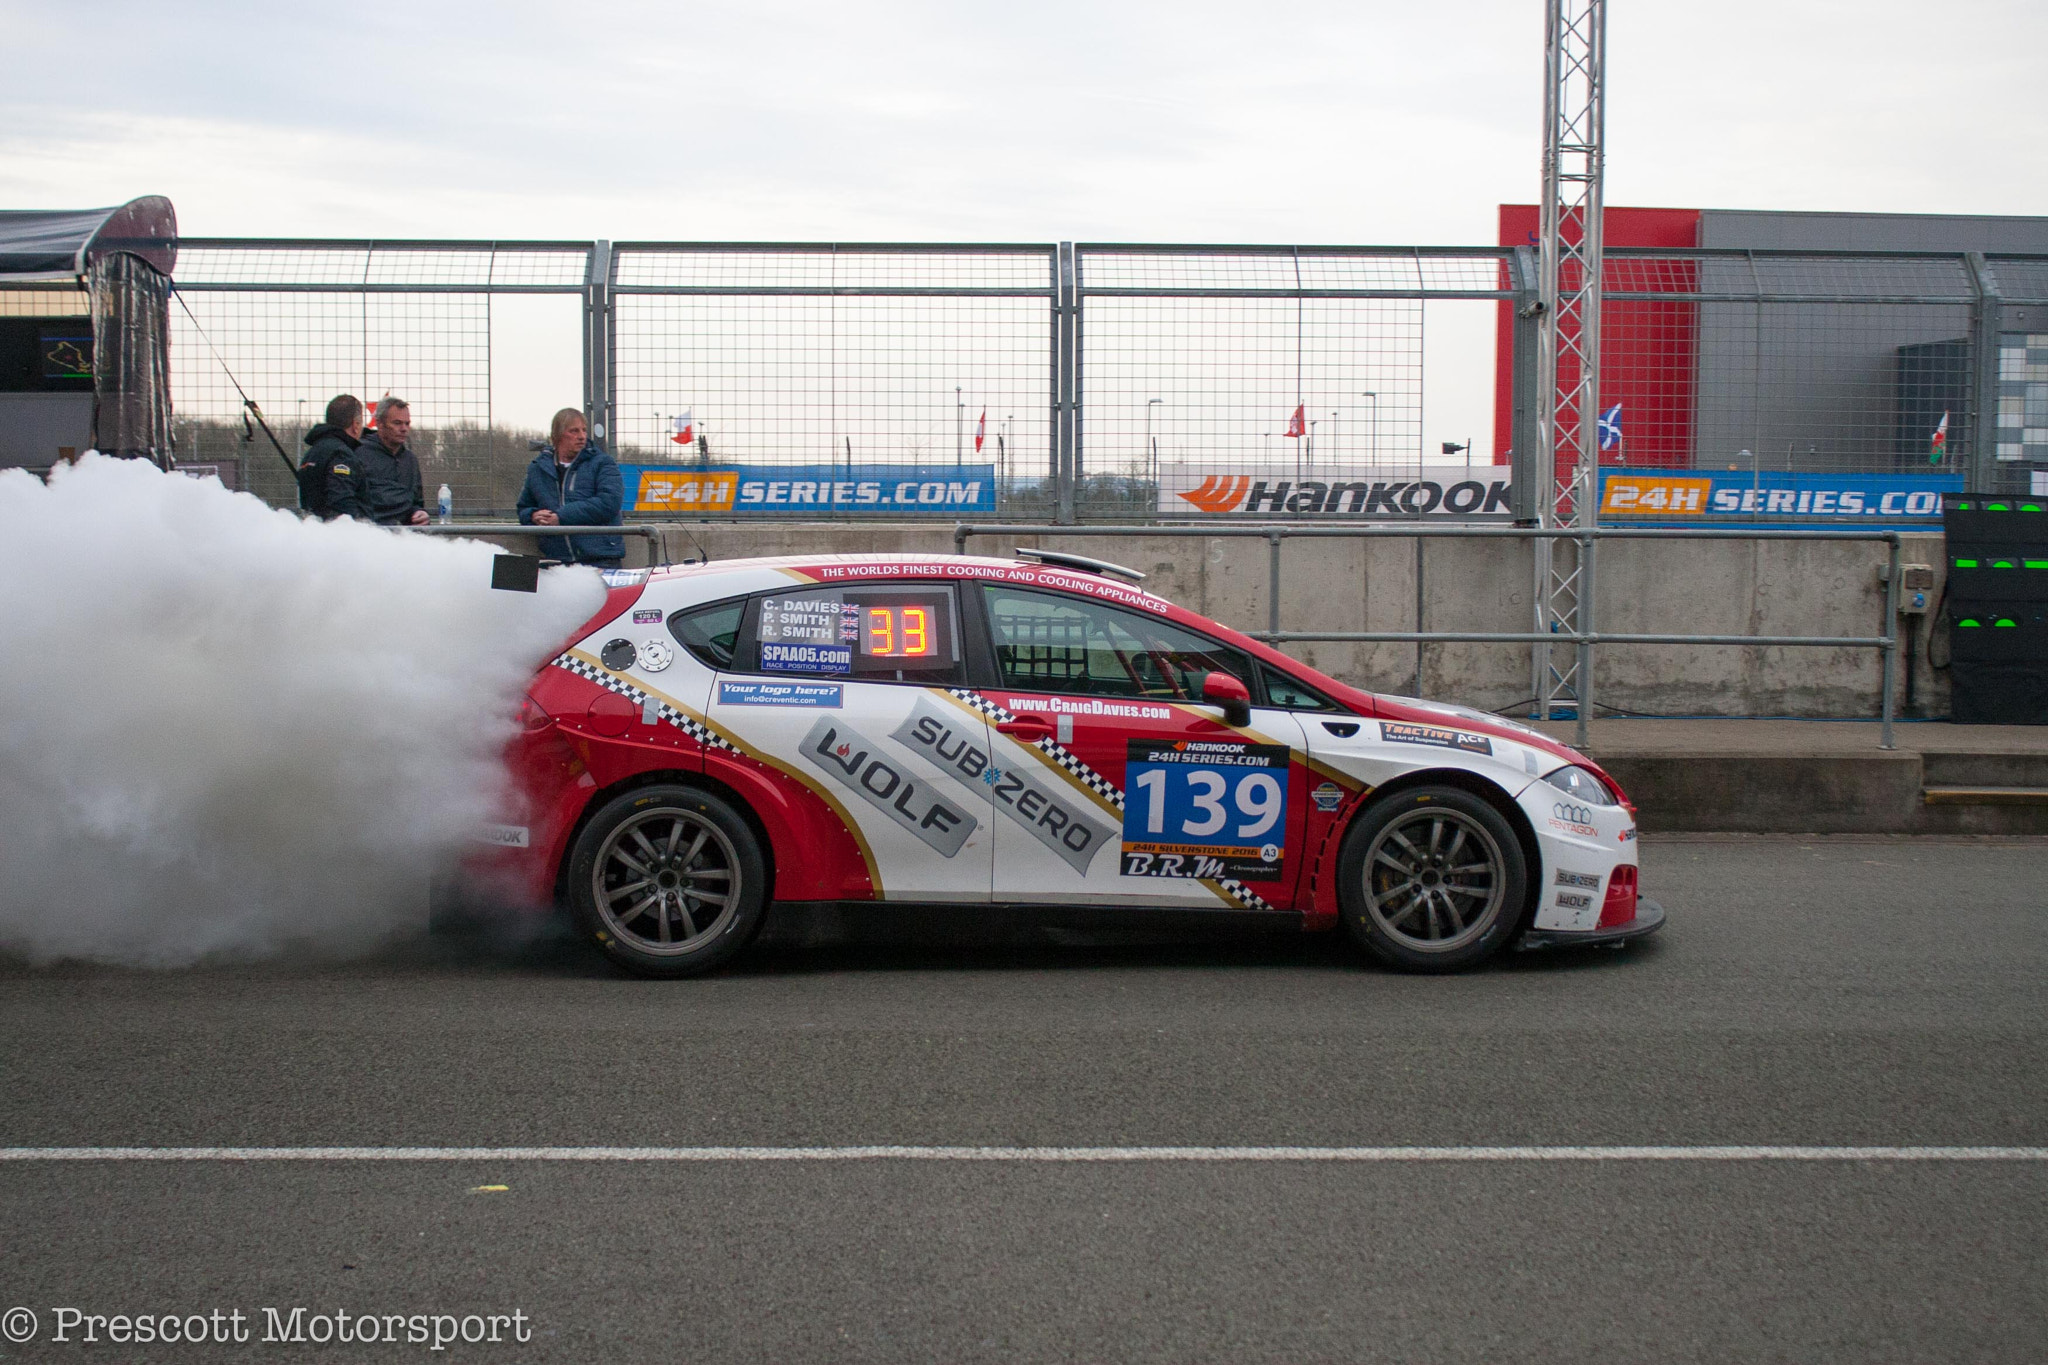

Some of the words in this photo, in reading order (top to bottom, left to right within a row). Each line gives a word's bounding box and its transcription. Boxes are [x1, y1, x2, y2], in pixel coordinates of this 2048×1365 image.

[740, 481, 982, 504] SERIES.COM
[1713, 488, 1944, 515] SERIES.CO
[822, 567, 845, 577] THE
[846, 565, 900, 576] WORLDS
[902, 565, 944, 575] FINEST
[946, 565, 1005, 578] COOKING
[1007, 570, 1035, 582] AND
[1037, 574, 1094, 593] COOLING
[1095, 586, 1168, 613] APPLIANCES
[763, 599, 779, 610] C.
[783, 600, 840, 614] DAVIES
[763, 612, 775, 623] P.
[780, 613, 830, 626] SMITH
[762, 625, 777, 636] R.
[782, 626, 832, 639] SMITH
[870, 609, 926, 655] 33
[723, 683, 757, 694] Your
[760, 684, 791, 696] logo
[795, 686, 838, 696] here?
[744, 695, 817, 705] info@creventic.com
[1457, 734, 1486, 744] ACE
[1148, 752, 1183, 762] 24H
[1182, 754, 1270, 767] SERIES.COM
[816, 727, 962, 833] WOLF
[1136, 769, 1282, 838] 139
[1548, 819, 1599, 837] PENTAGON
[1133, 843, 1155, 851] 24H
[1158, 845, 1229, 855] SILVERSTONE
[1231, 848, 1258, 856] 2016
[1262, 847, 1277, 858] A3
[1559, 894, 1589, 908] WOLF
